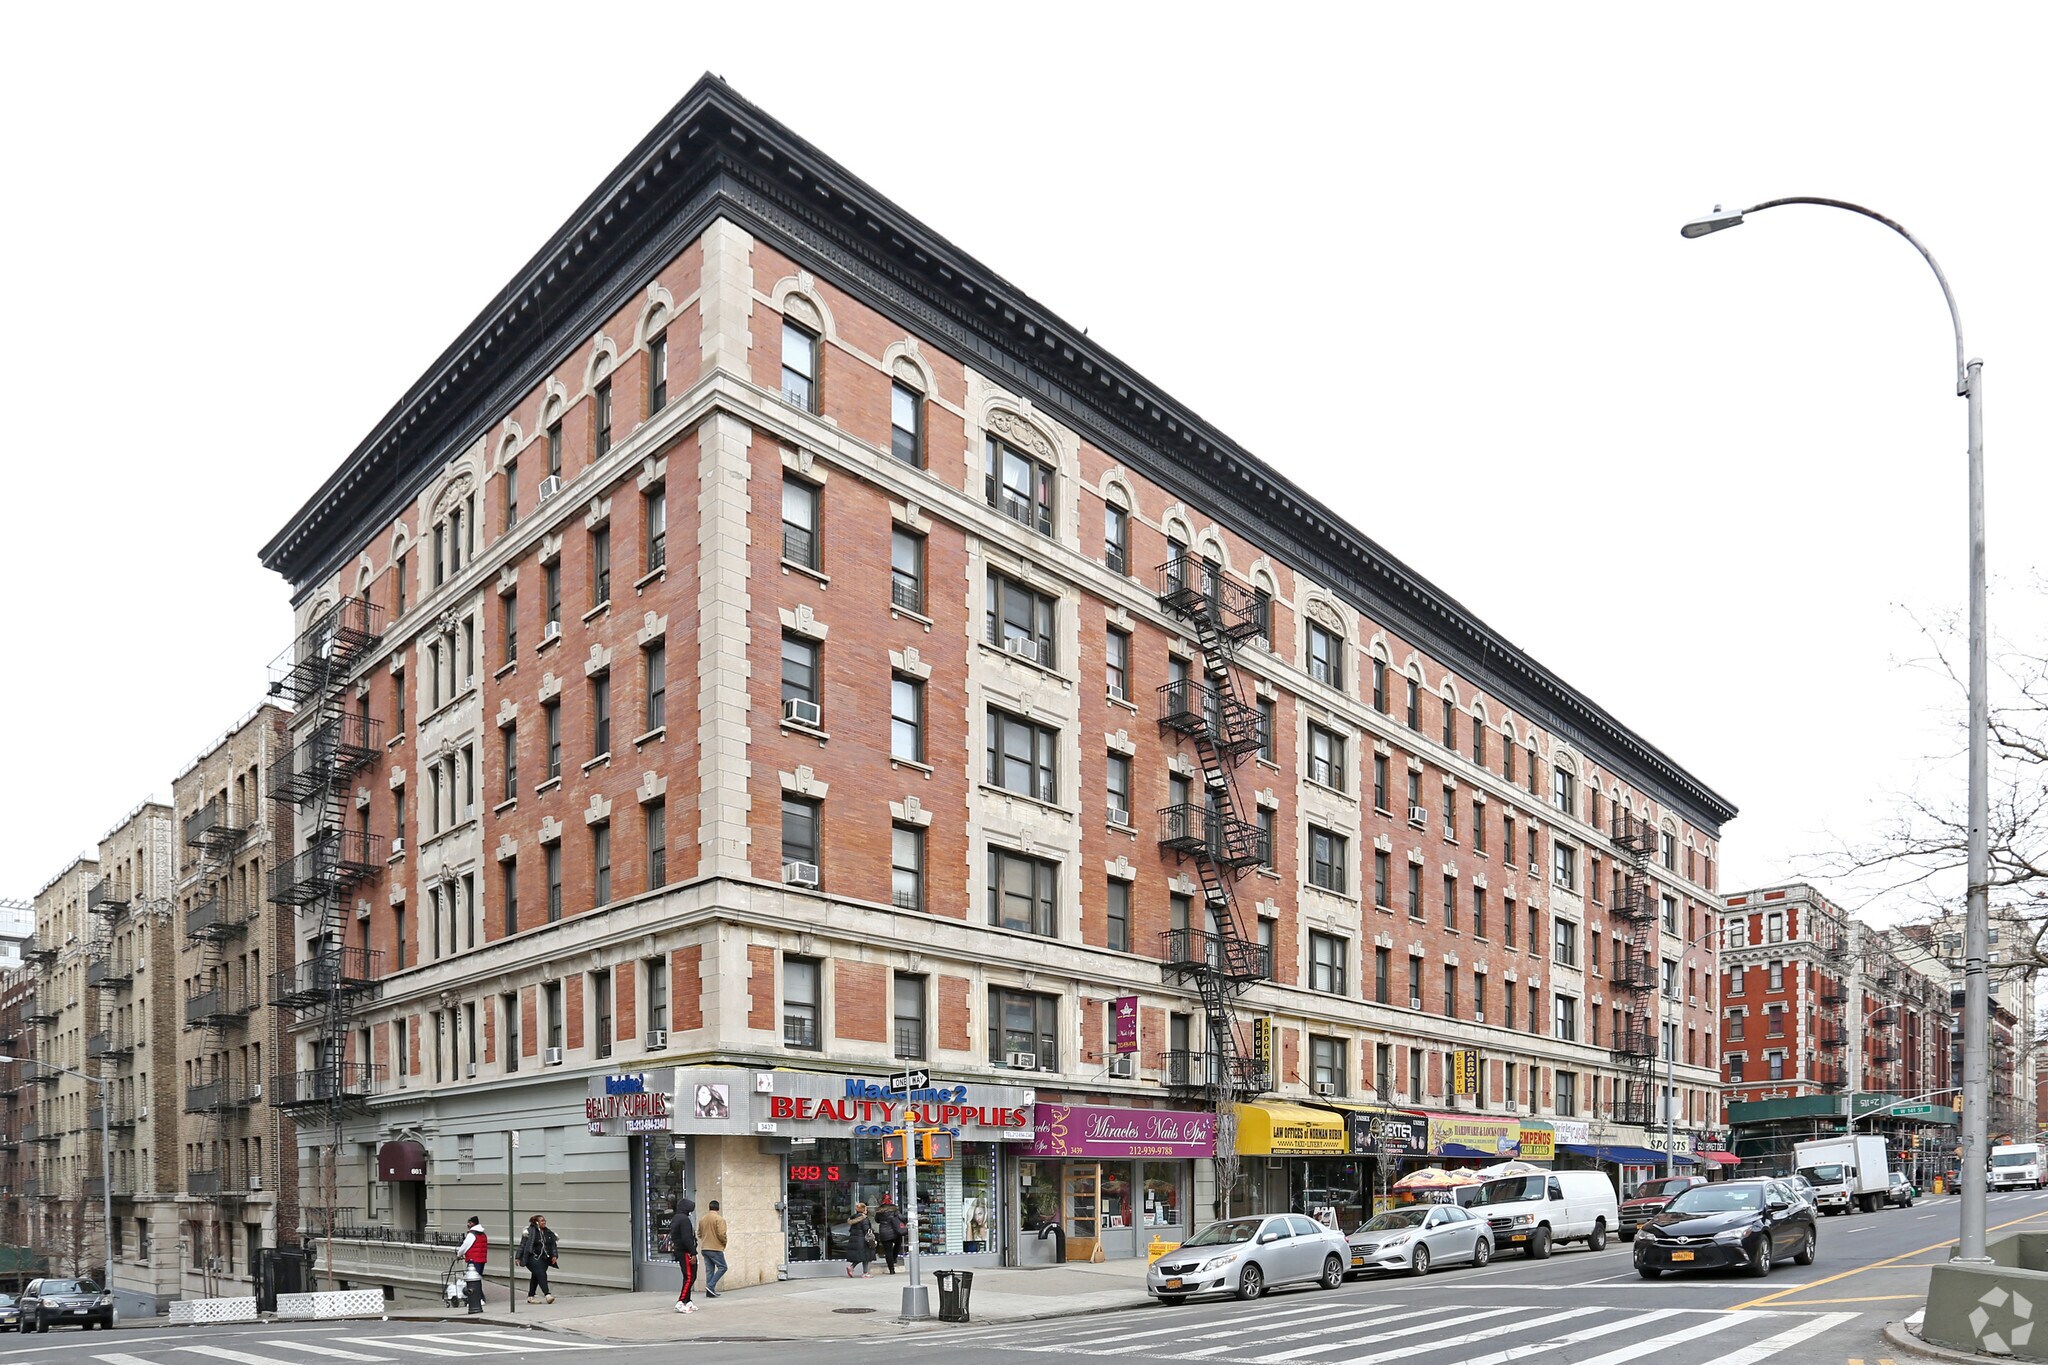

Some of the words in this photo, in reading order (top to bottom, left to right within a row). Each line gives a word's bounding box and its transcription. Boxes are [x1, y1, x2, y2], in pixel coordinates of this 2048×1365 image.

[1466, 1051, 1476, 1093] HARDWARE
[895, 1078, 907, 1087] ONE
[911, 1075, 924, 1084] WAY
[953, 1085, 968, 1103] 2
[585, 1096, 620, 1119] BEAUTY
[624, 1092, 667, 1117] SUPPLIES
[770, 1096, 897, 1122] BEAUTY
[905, 1103, 1026, 1127] SUPPLIES
[588, 1122, 600, 1133] 3437
[760, 1123, 774, 1131] 3437
[1084, 1113, 1139, 1138] Miracles
[1145, 1115, 1179, 1139] Nails
[1183, 1119, 1207, 1147] Spa
[1273, 1126, 1284, 1138] LAW
[1284, 1127, 1304, 1139] OFFICES
[1309, 1128, 1328, 1140] NORMAN
[1328, 1129, 1342, 1140] RUBIN
[1454, 1125, 1480, 1137] HARDWARE
[1520, 1130, 1551, 1145] EMPEÑOS
[1129, 1146, 1173, 1155] 212-939-9788
[1521, 1145, 1532, 1154] CASH
[1533, 1146, 1549, 1155] LOANS
[1717, 1143, 1726, 1152] DELI
